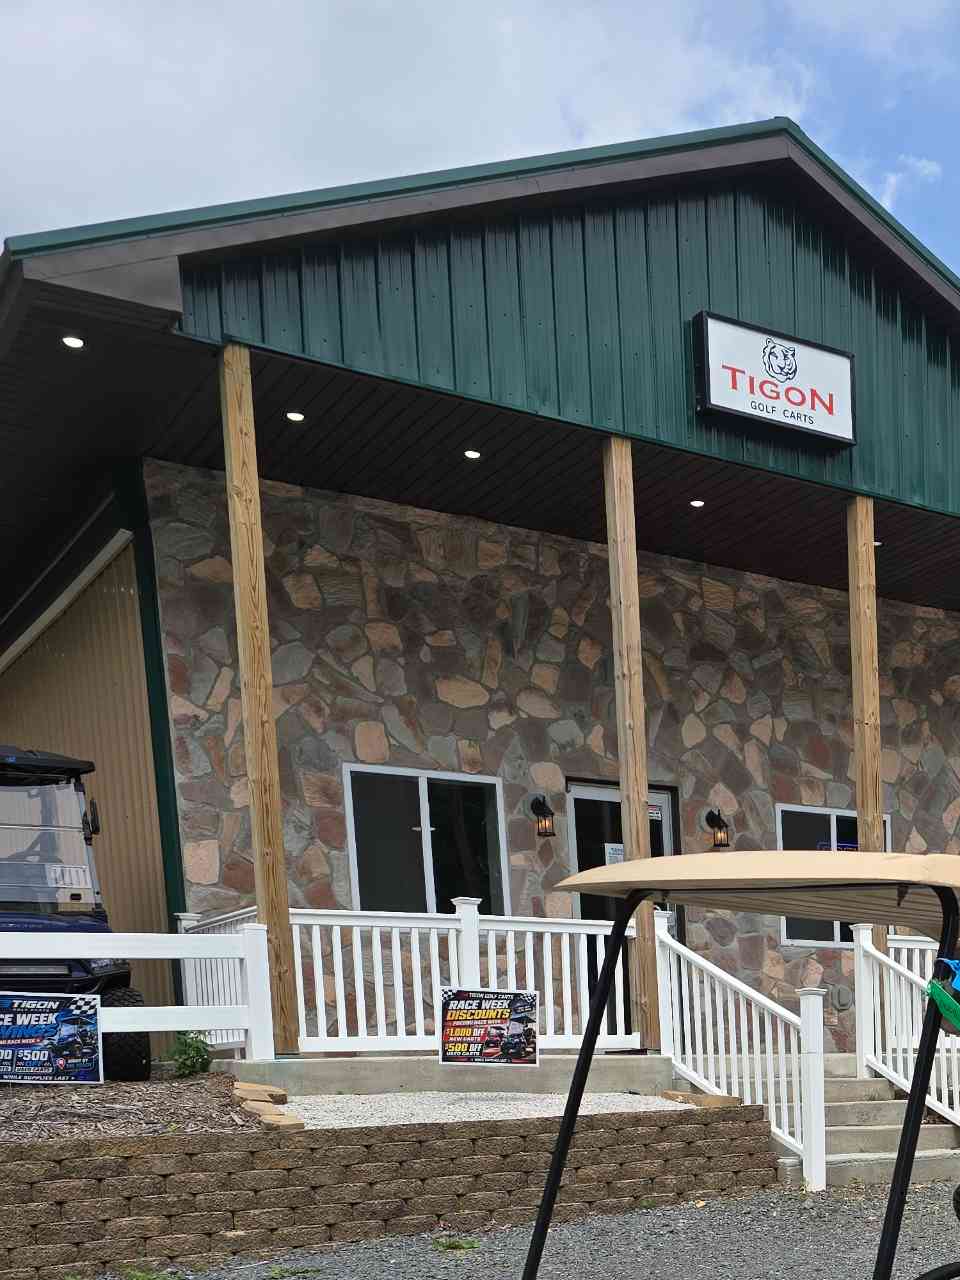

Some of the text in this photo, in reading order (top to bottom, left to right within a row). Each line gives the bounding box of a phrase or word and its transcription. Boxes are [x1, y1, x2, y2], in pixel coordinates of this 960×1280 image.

[721, 363, 834, 416] TIGON
[750, 401, 815, 425] GOLF CARTS
[13, 999, 60, 1009] TIGON
[448, 1000, 480, 1010] RACE
[480, 999, 510, 1010] WEEK
[16, 1012, 56, 1025] WEEK
[446, 1008, 511, 1020] DISCOUNTS
[17, 1049, 49, 1061] $500
